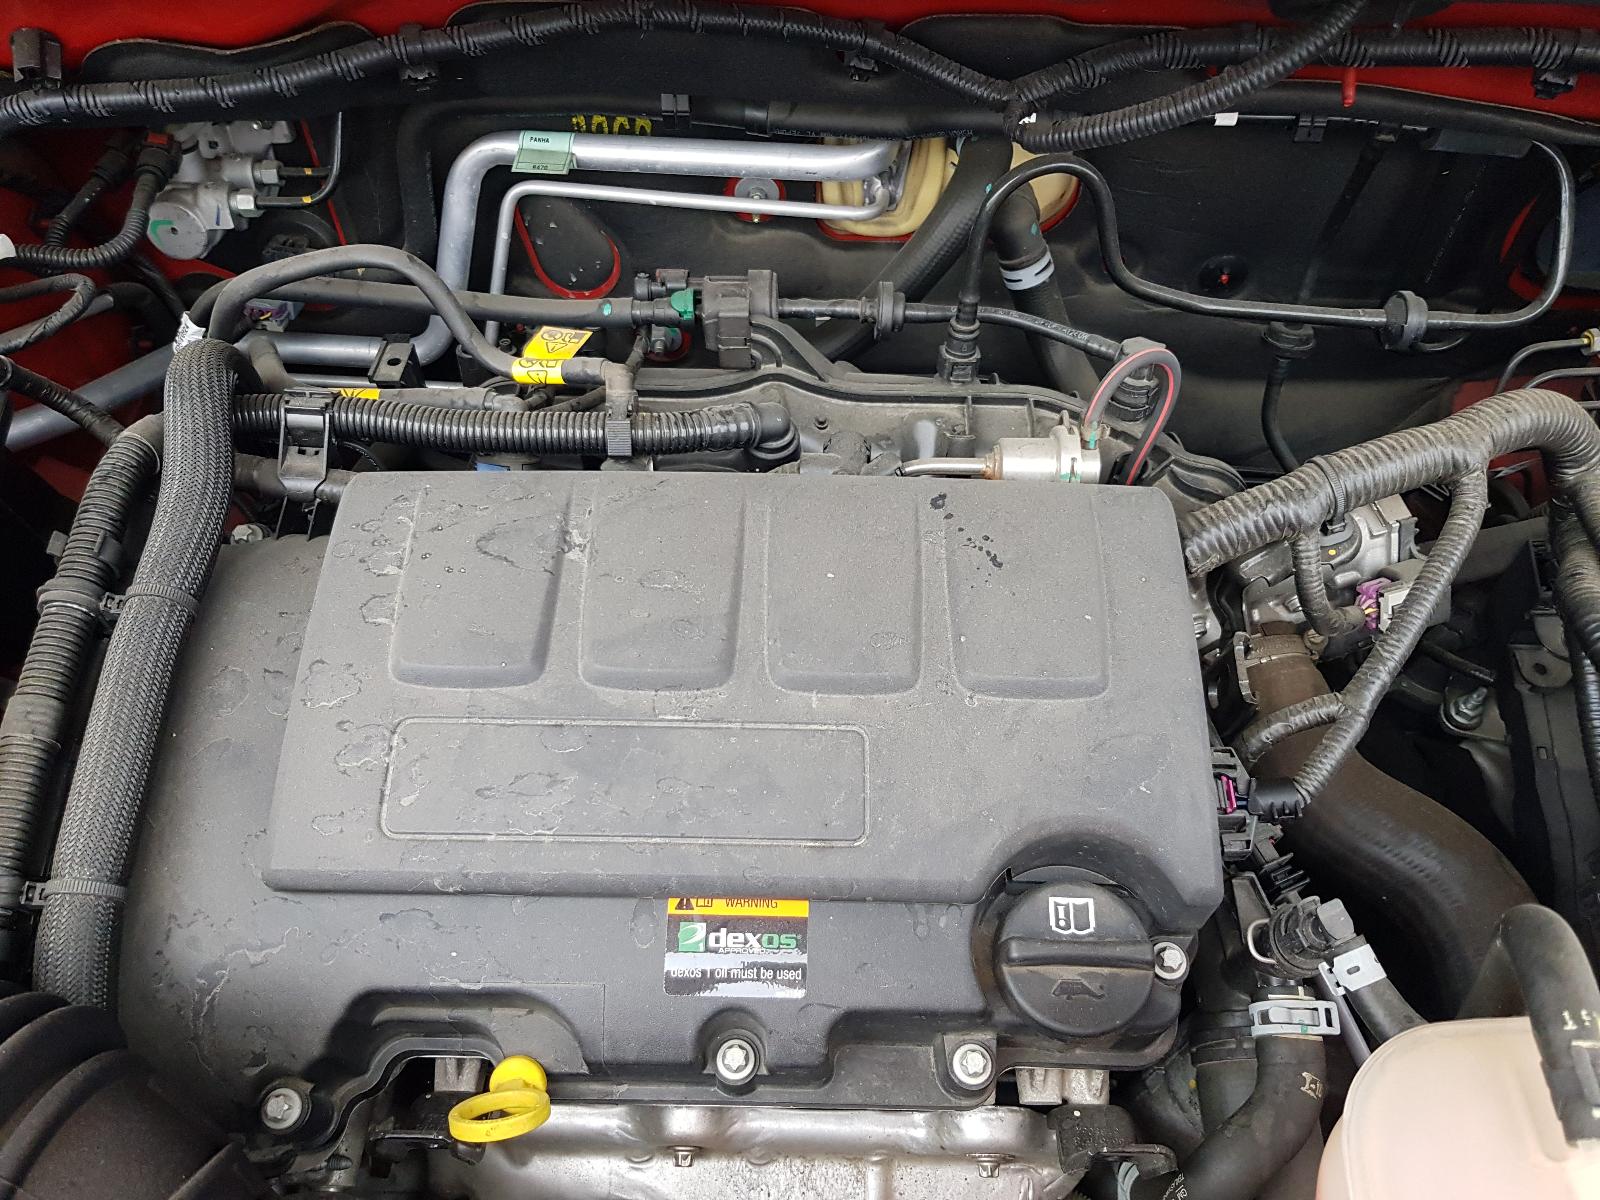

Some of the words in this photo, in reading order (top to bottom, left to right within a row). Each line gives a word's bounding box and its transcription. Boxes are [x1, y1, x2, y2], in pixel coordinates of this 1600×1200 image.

[725, 898, 778, 909] WARNING
[708, 927, 798, 949] dexos
[730, 968, 758, 979] must
[760, 967, 774, 979] be
[776, 967, 802, 979] used
